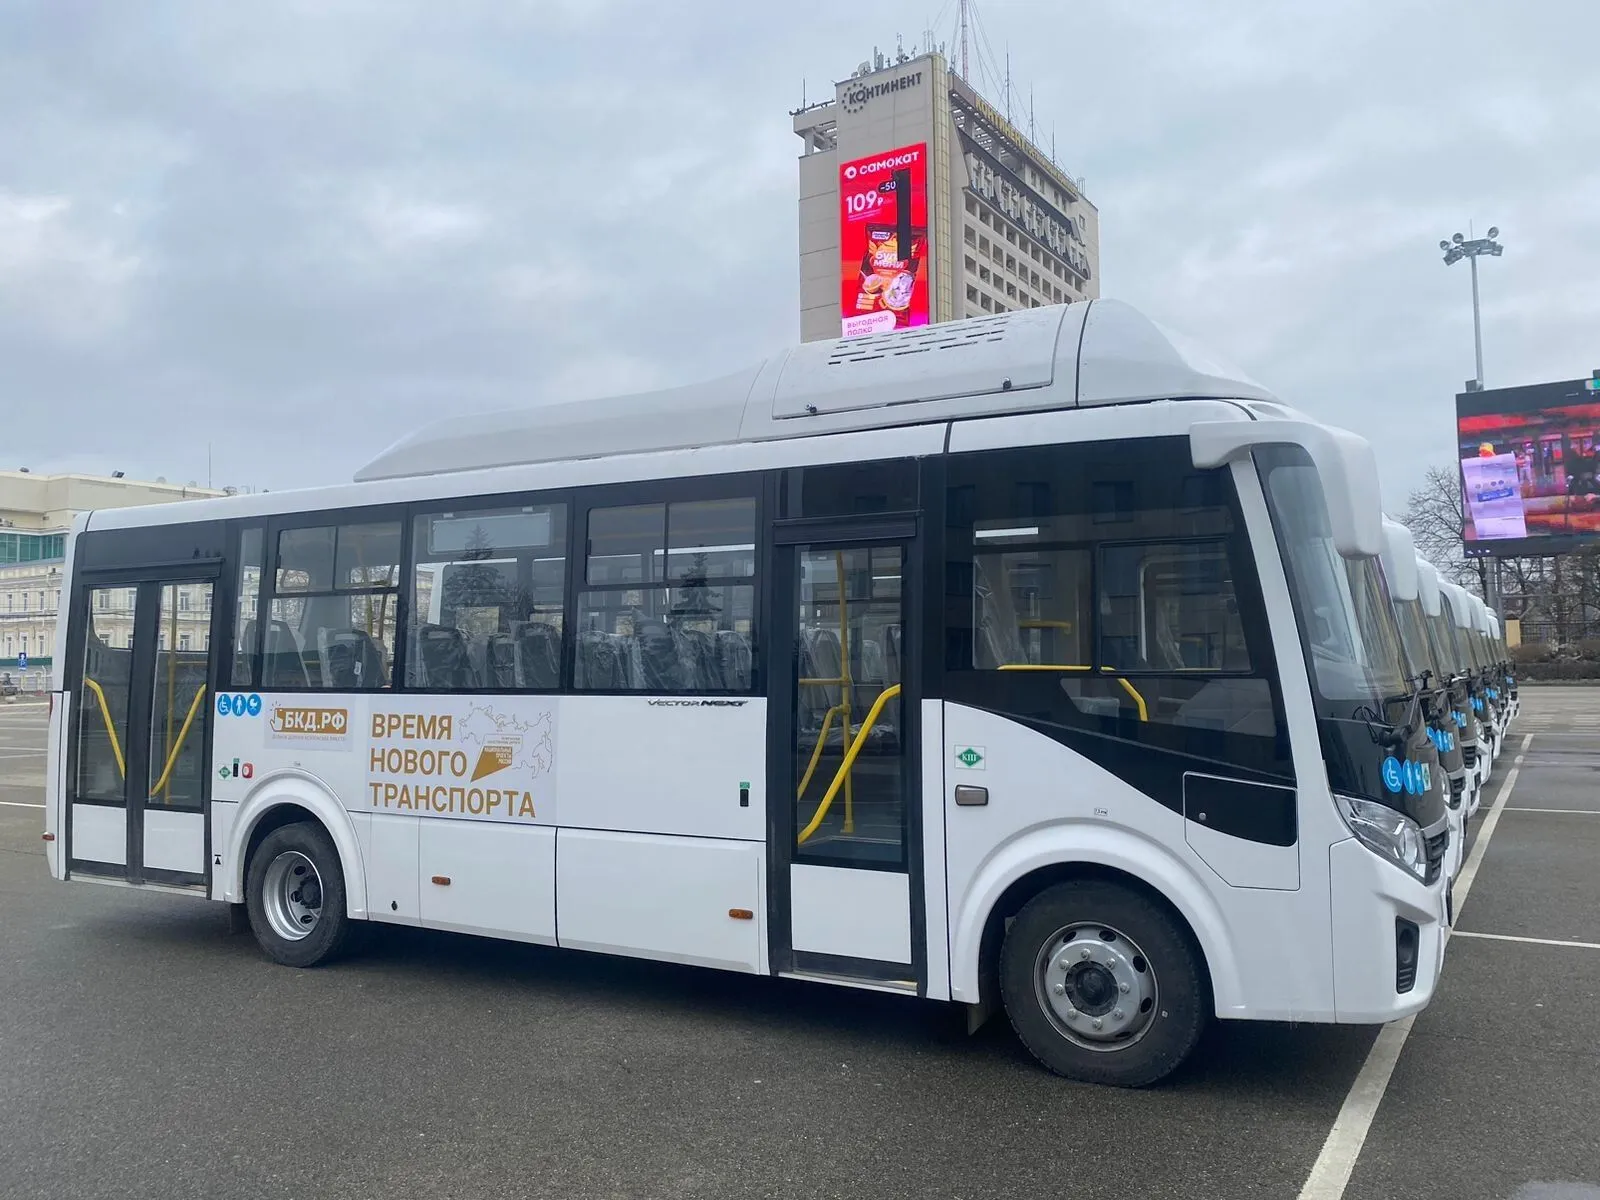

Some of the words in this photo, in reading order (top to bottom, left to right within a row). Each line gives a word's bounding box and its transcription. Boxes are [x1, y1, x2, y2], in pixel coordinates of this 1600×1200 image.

[849, 72, 922, 104] КОНТИНЕНТ
[860, 151, 919, 175] самокат
[285, 711, 345, 732] БКД.РФ
[371, 713, 453, 741] ВРЕМЯ
[370, 747, 467, 778] НОВОГО
[369, 782, 536, 819] ТРАНСПОРТА
